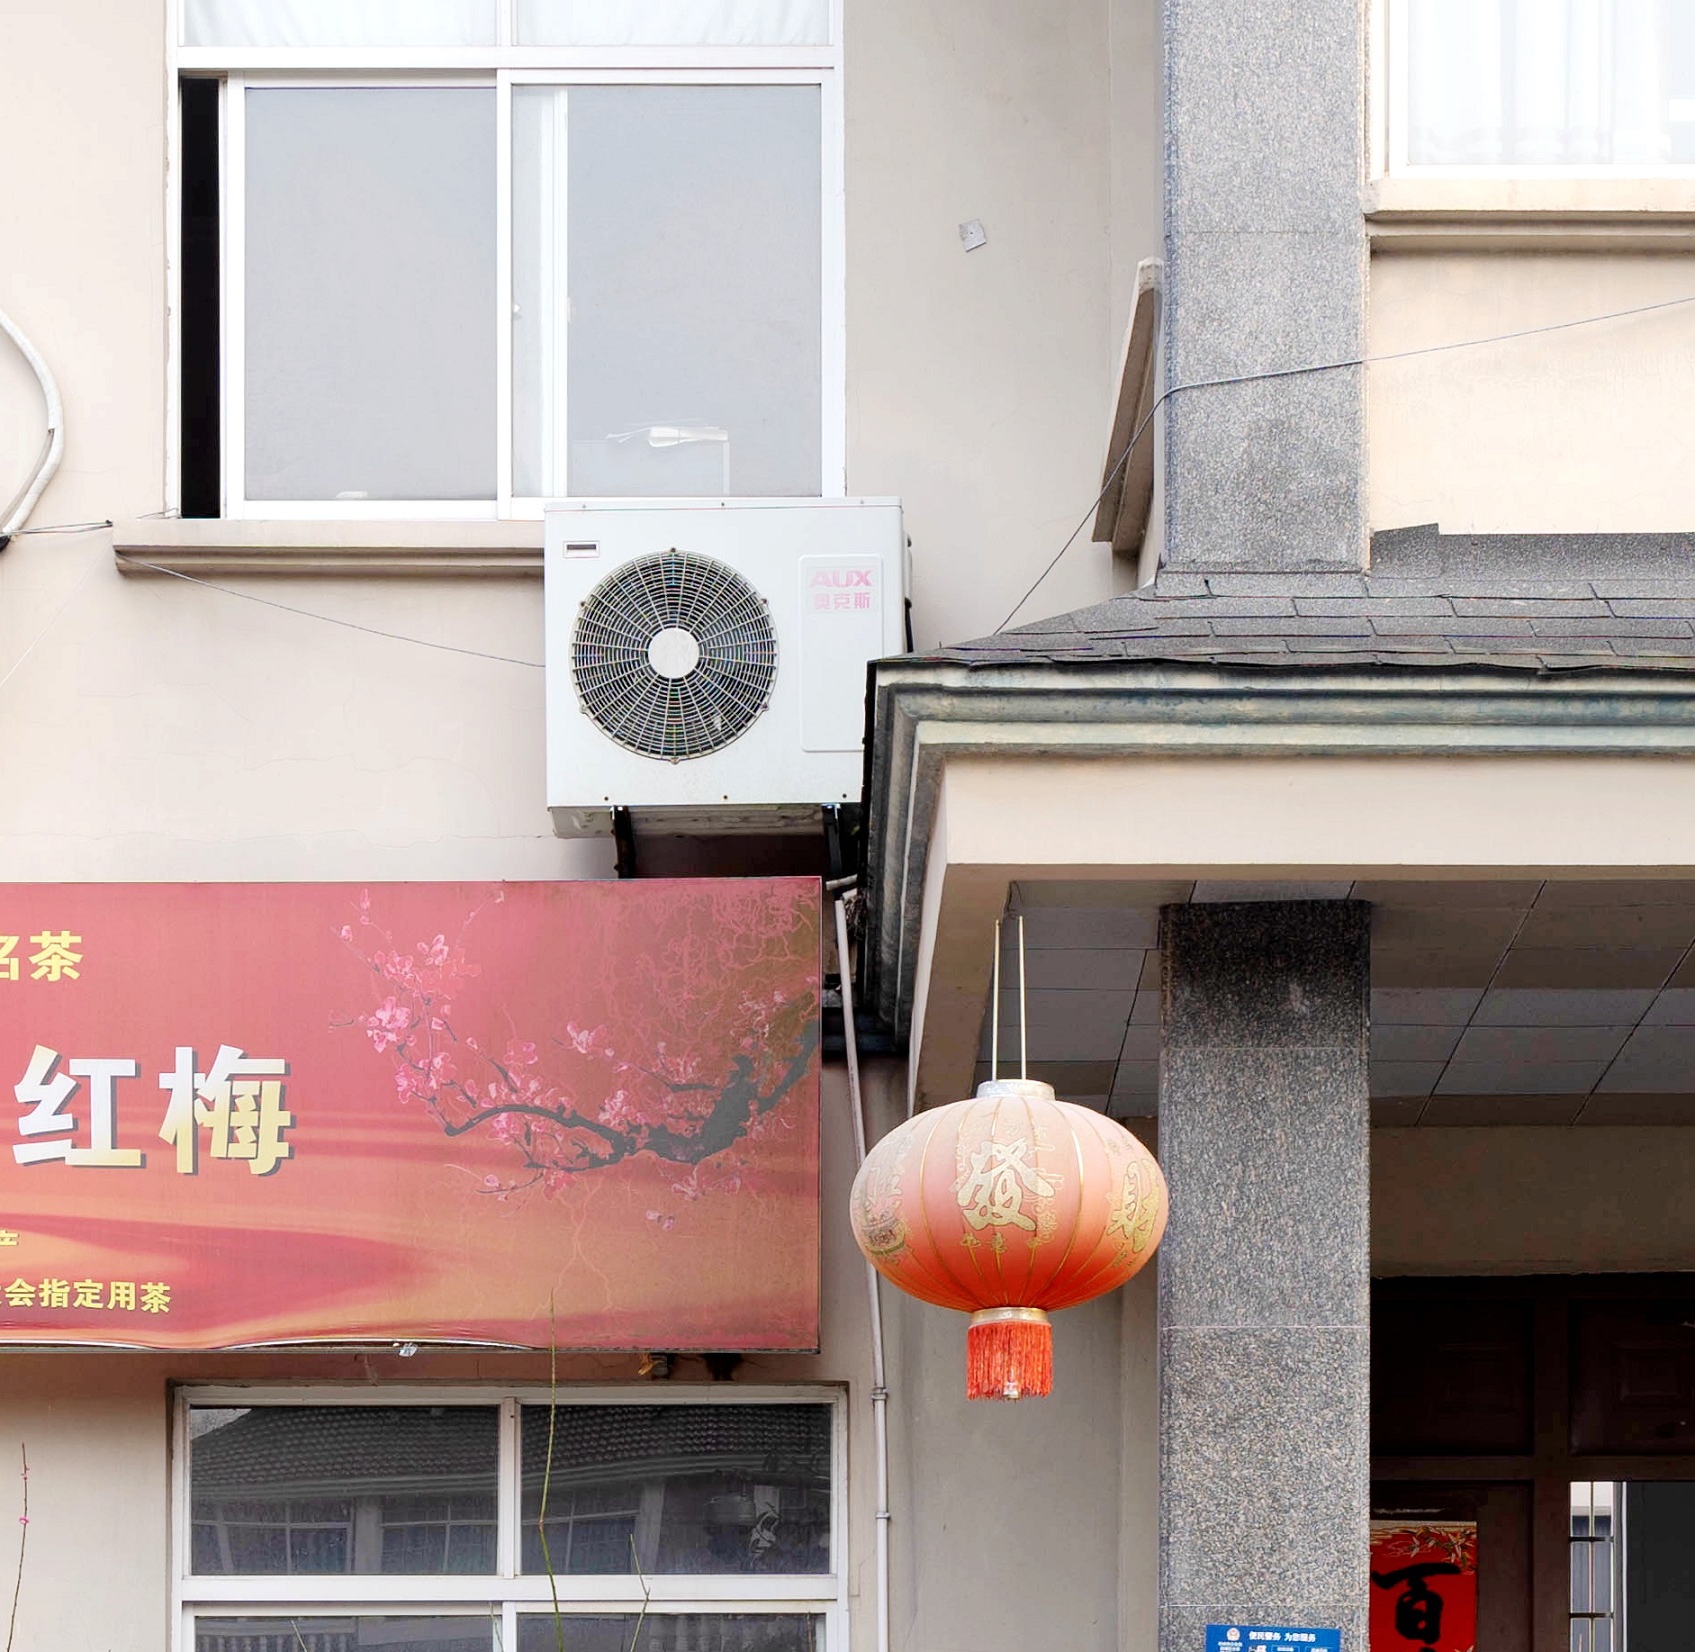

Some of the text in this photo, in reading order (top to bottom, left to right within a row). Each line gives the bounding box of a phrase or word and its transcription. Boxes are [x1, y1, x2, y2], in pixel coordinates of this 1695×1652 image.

[809, 569, 874, 588] AUX
[813, 592, 872, 611] 奥克斯
